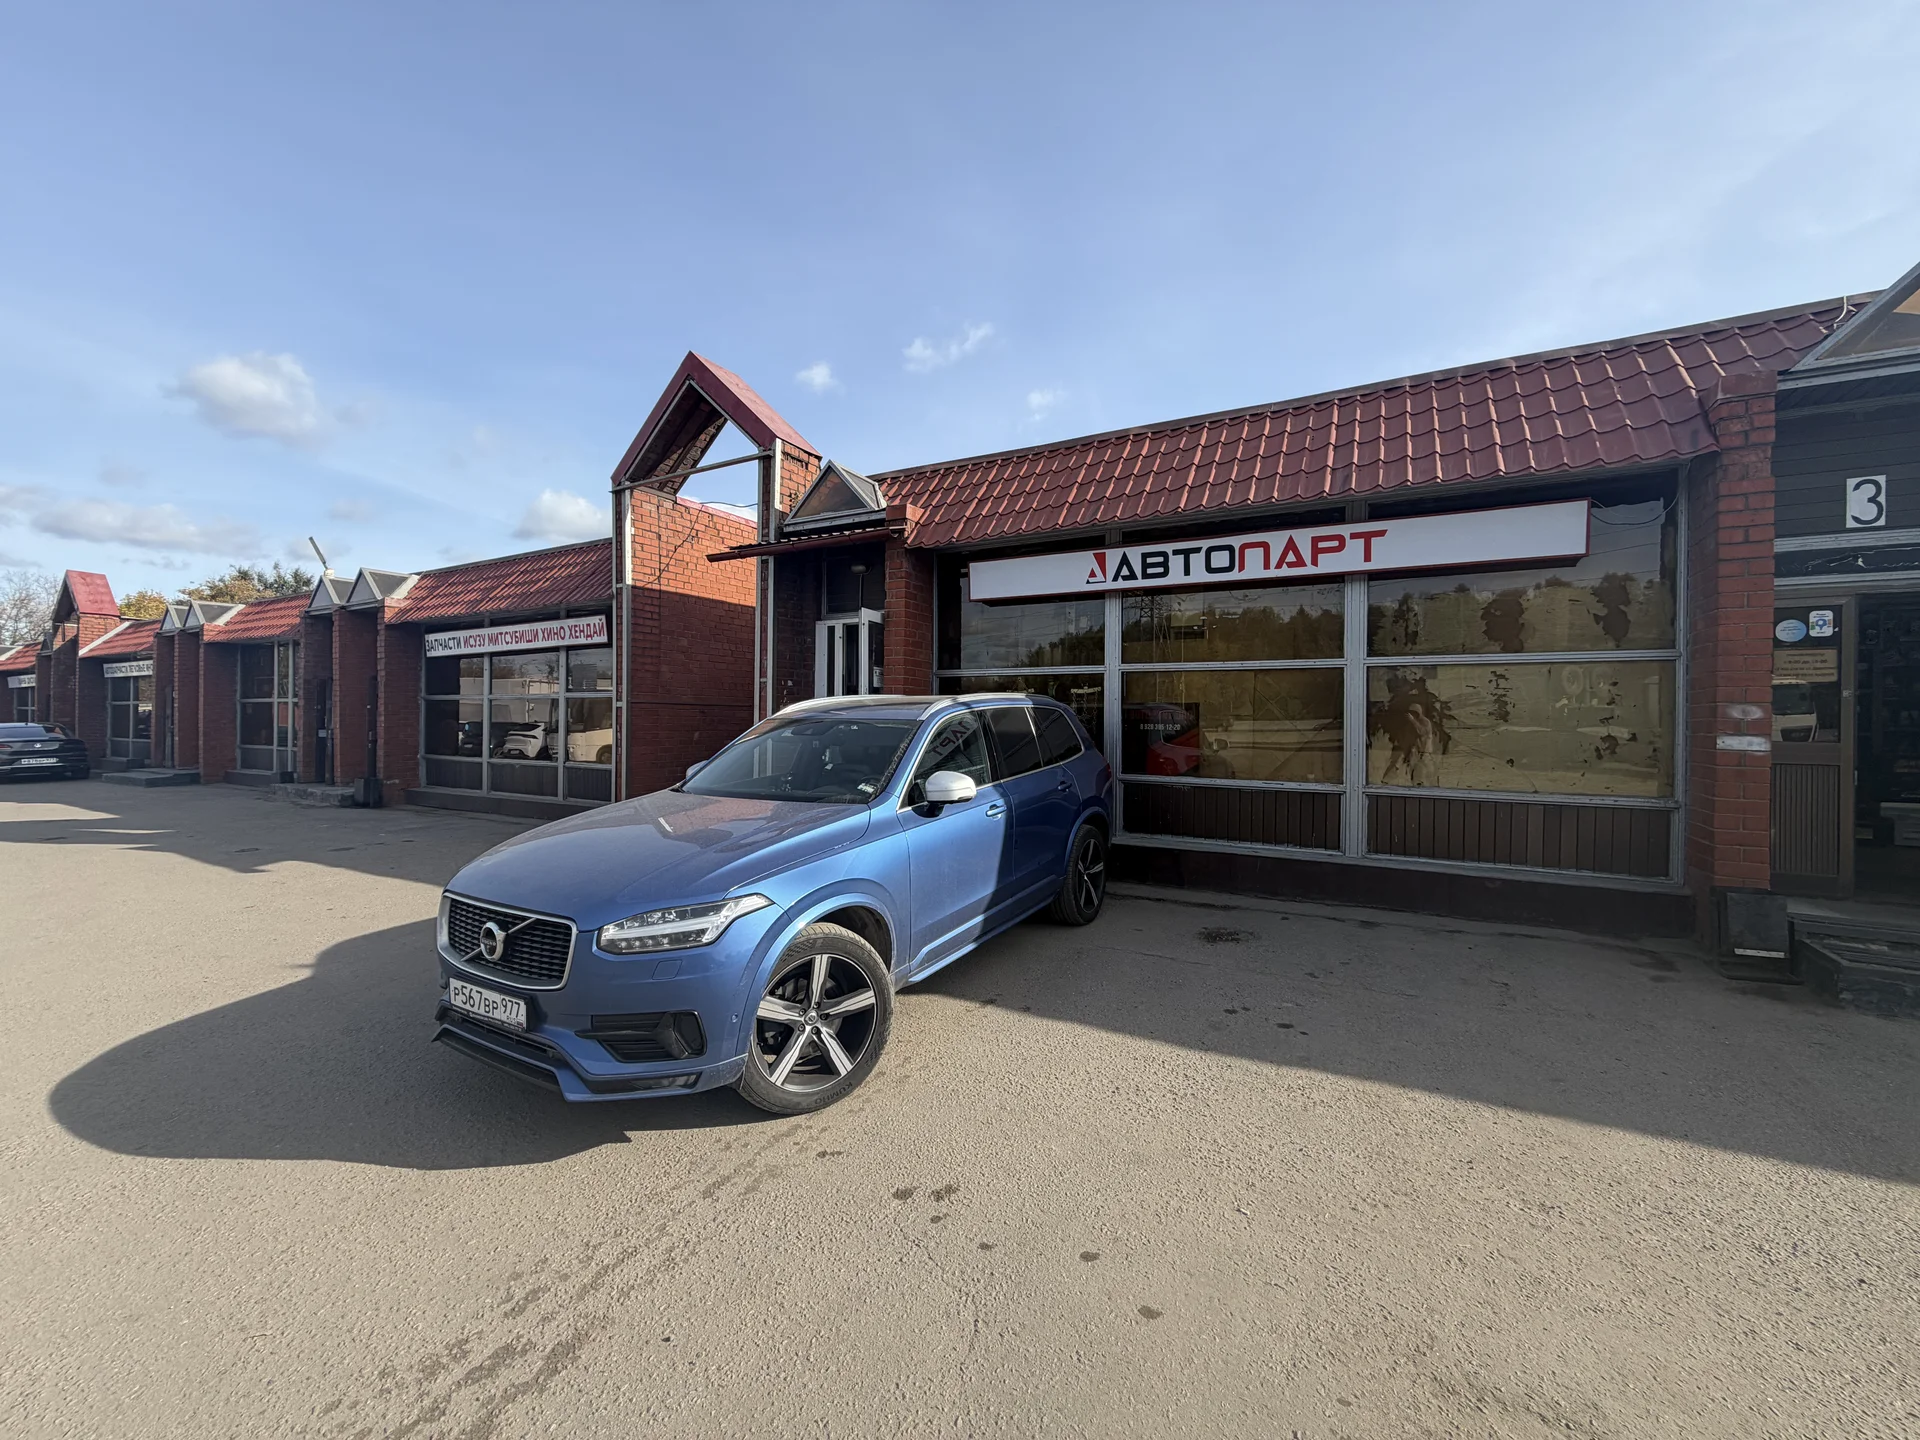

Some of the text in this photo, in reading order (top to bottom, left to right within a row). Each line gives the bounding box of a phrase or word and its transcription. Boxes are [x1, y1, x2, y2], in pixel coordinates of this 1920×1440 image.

[1850, 478, 1884, 526] 3
[1111, 528, 1389, 582] АВТОПАРТ
[425, 617, 605, 653] ЗАПЧАСТИ ИСУЗУ МИТСУБИШИ ХИНО ХЕНДАЙ
[814, 1081, 853, 1105] KUMHO
